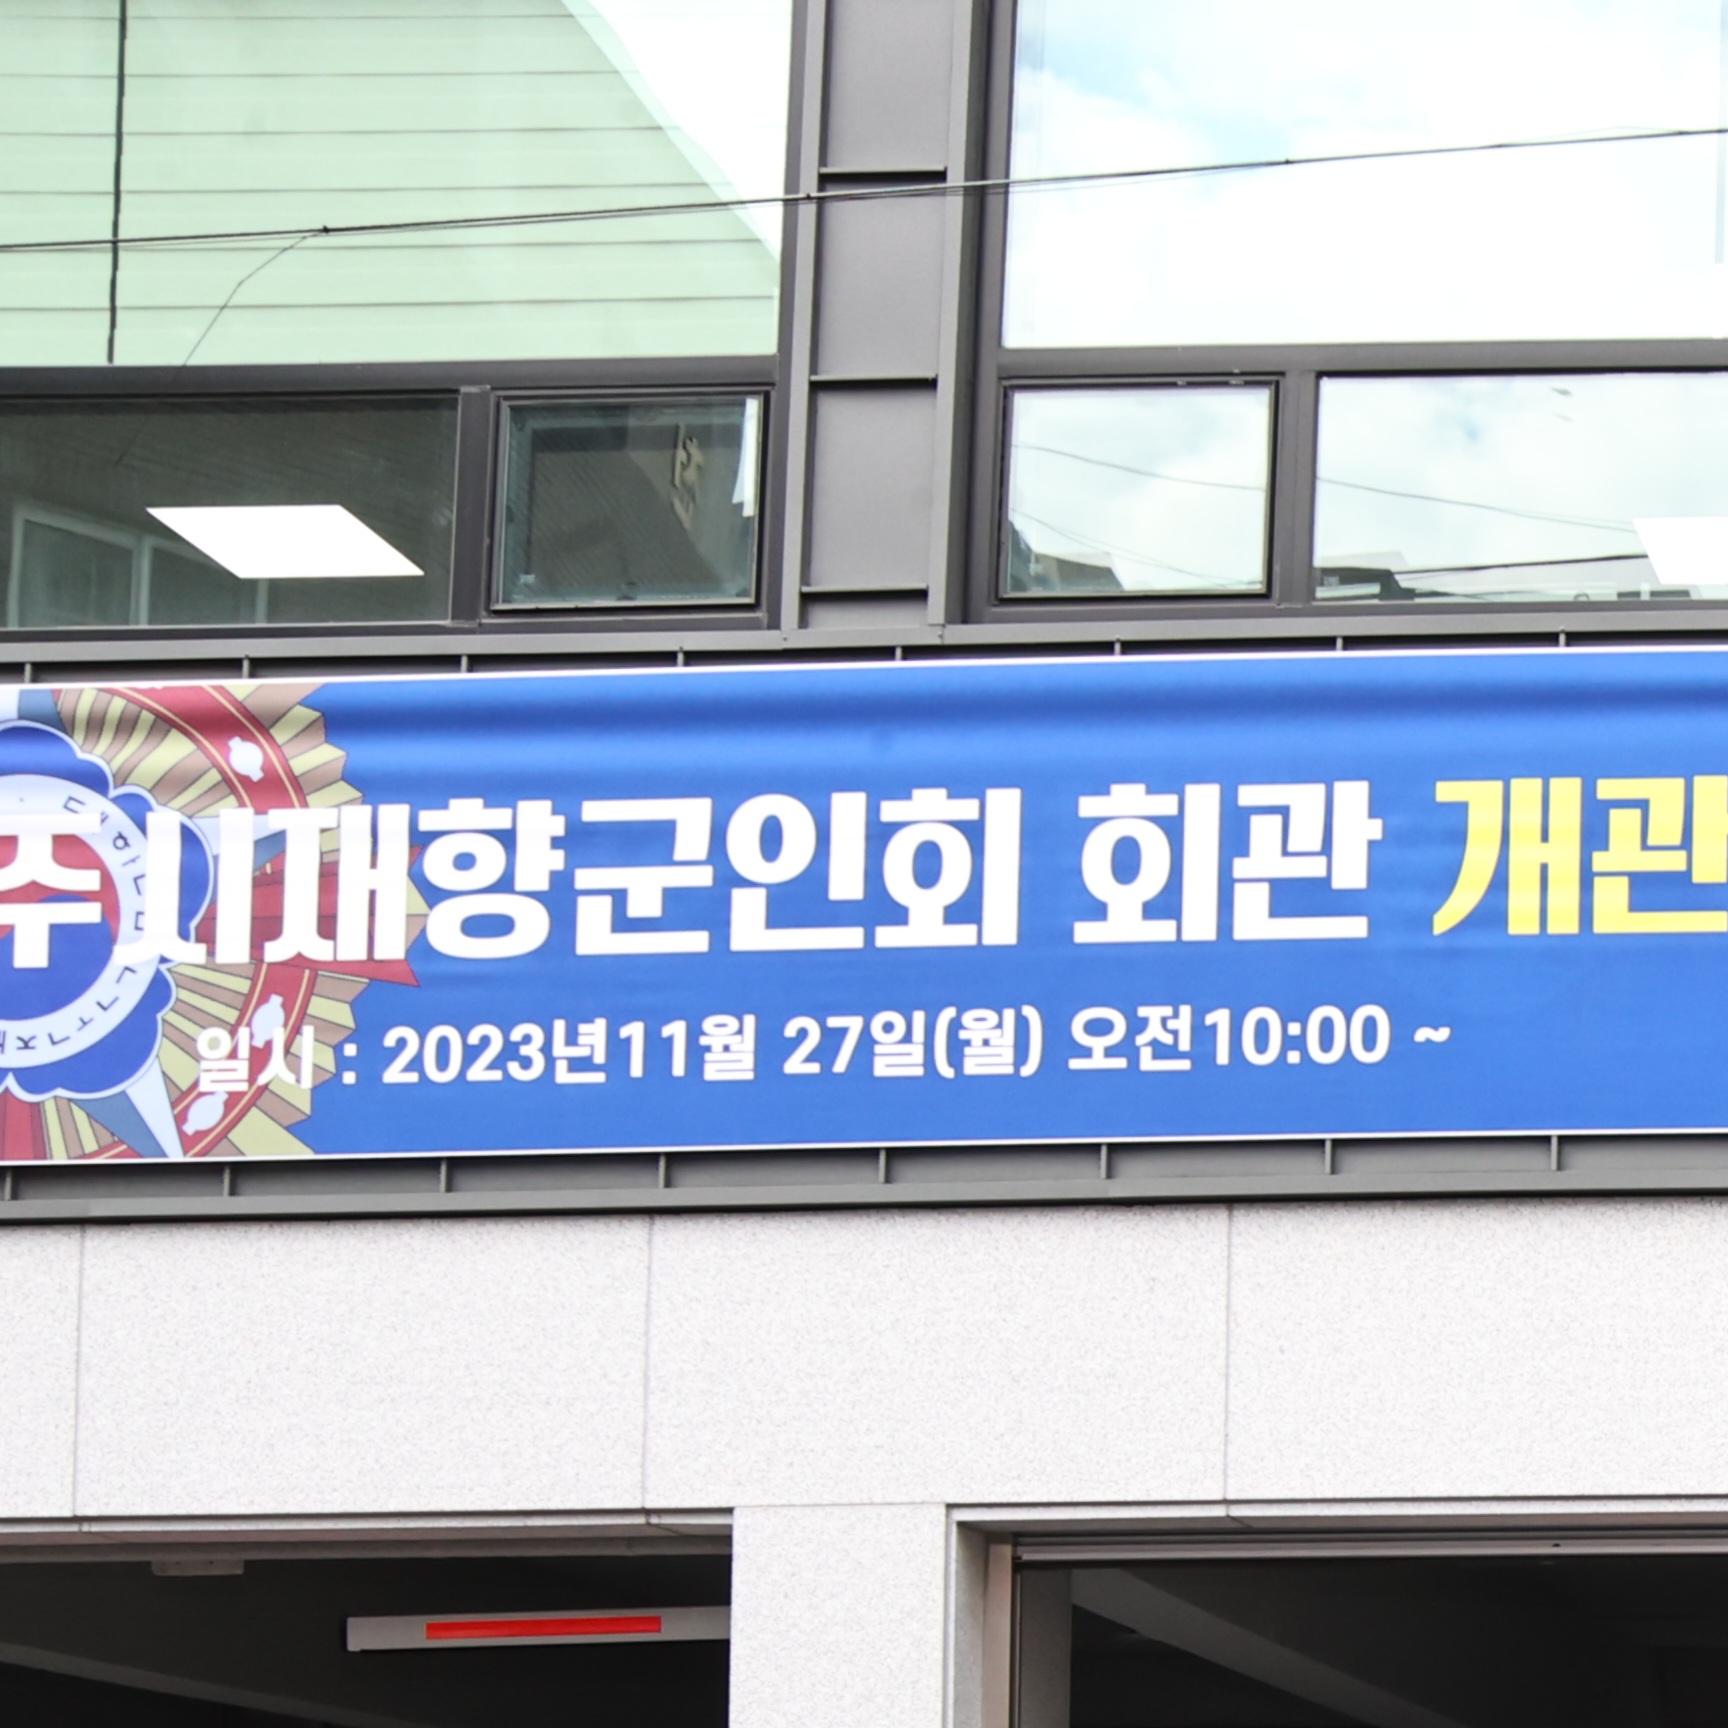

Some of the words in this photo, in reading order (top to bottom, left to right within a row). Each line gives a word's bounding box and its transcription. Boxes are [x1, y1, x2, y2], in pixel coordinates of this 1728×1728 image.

[1072, 780, 1382, 945] 회관
[196, 1026, 314, 1091] 일시
[382, 1015, 756, 1085] 2023년11월
[782, 1006, 1043, 1078] 27일(월)
